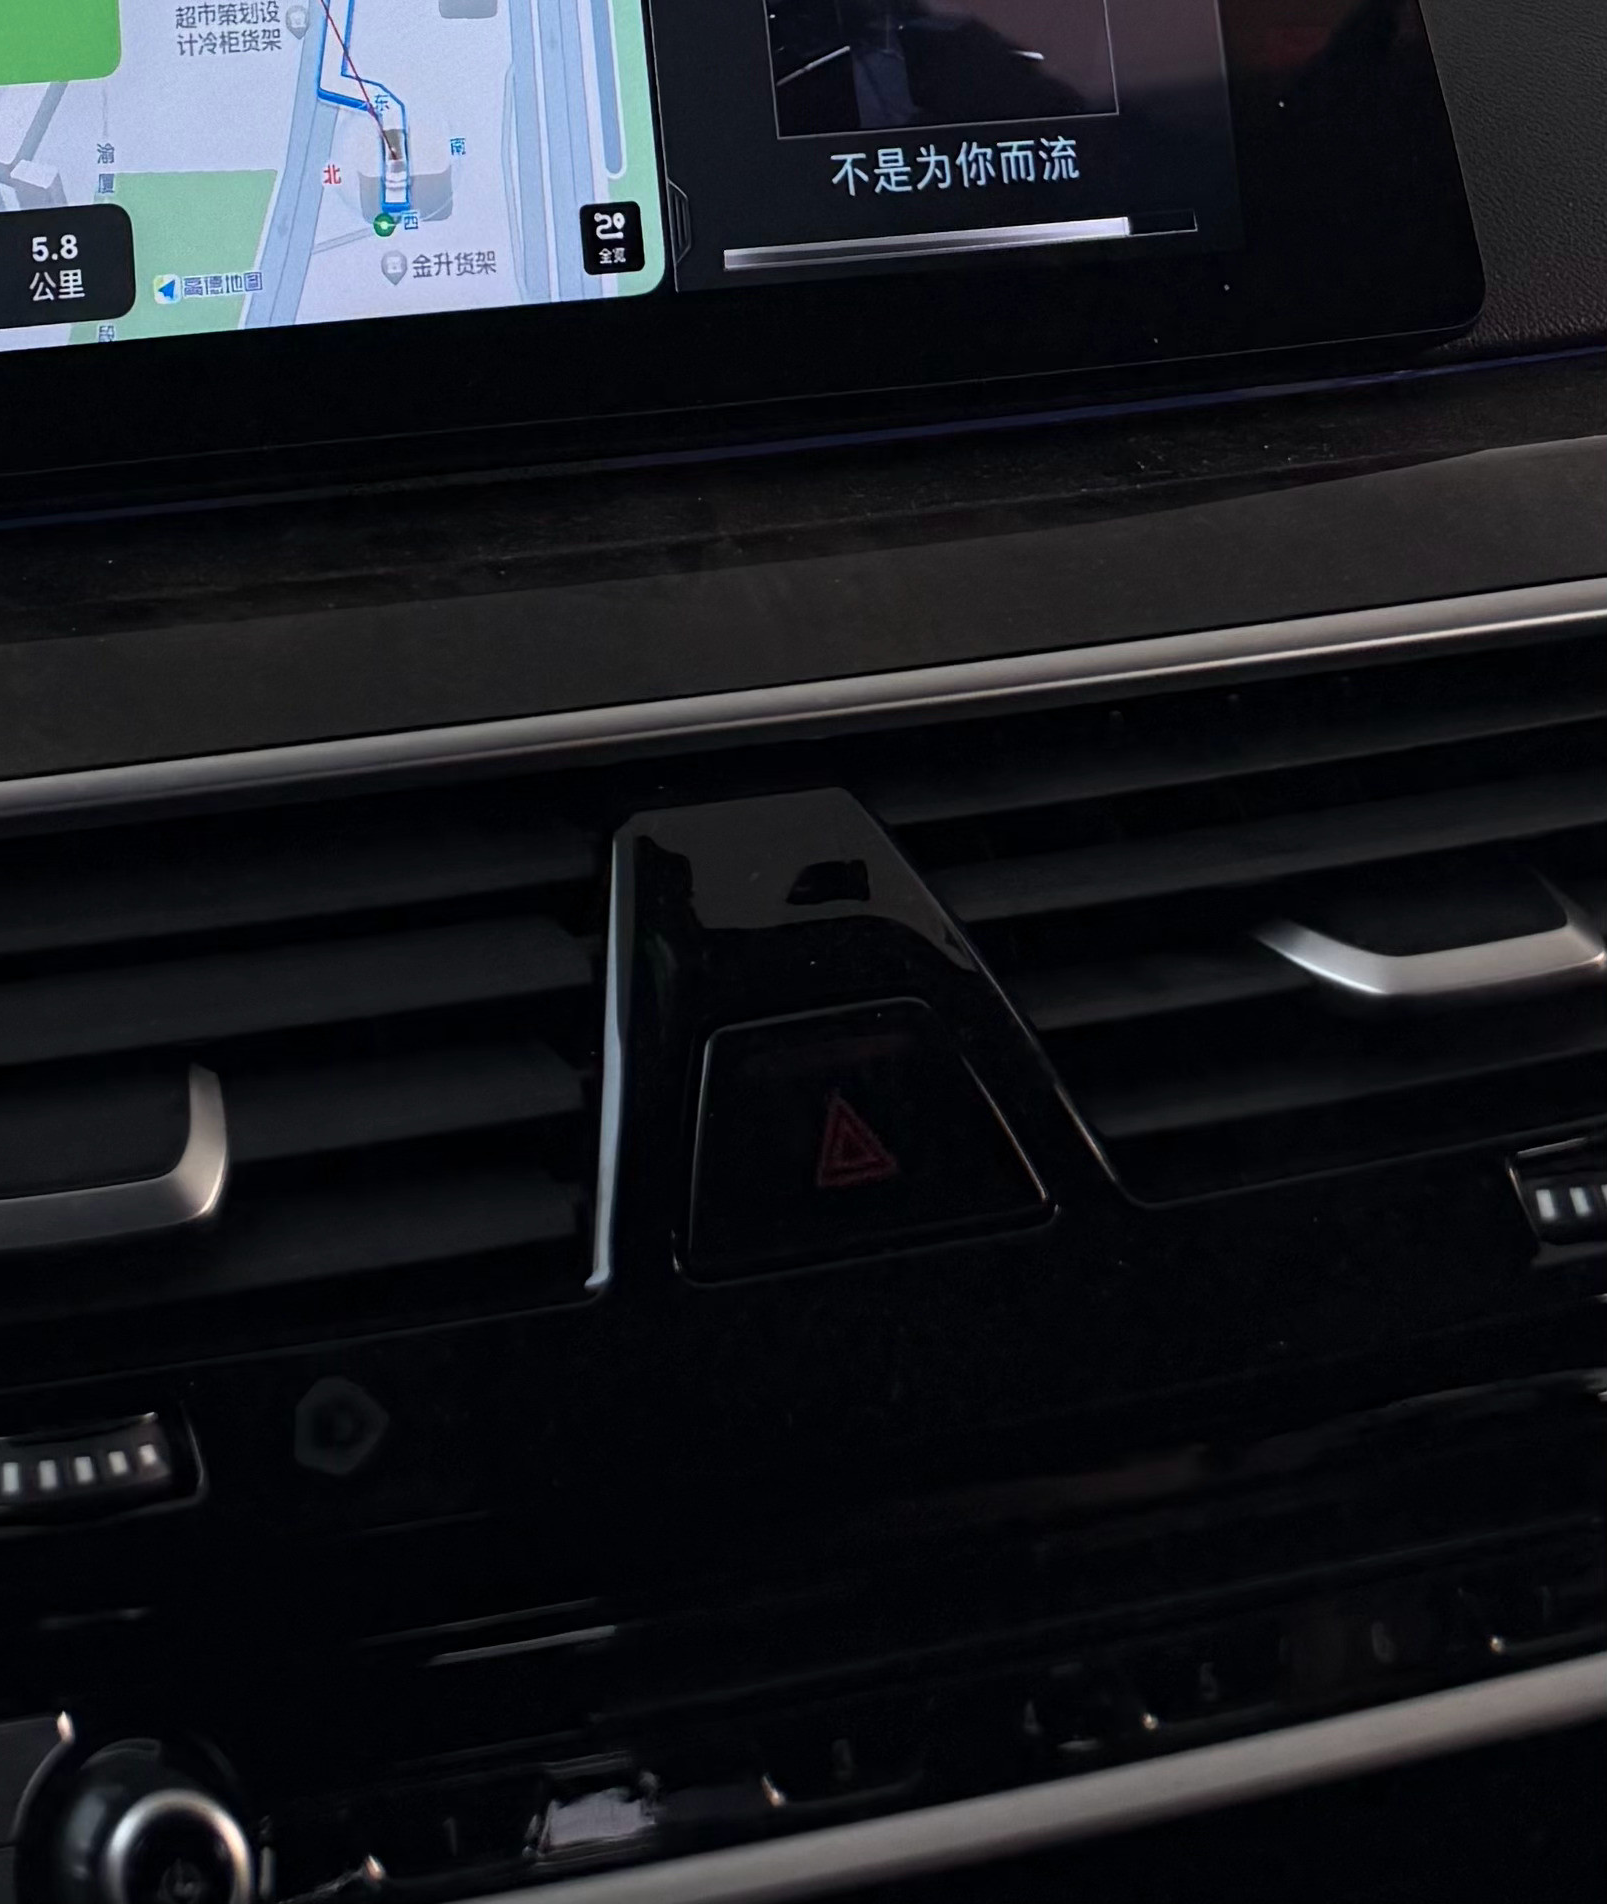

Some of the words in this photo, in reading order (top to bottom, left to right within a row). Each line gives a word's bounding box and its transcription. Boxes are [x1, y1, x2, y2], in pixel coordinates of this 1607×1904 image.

[175, 0, 282, 29] 超市策划设
[176, 28, 283, 57] 计冷柜货架
[323, 164, 342, 184] 北
[830, 136, 1081, 196] 不是为你而流
[30, 234, 79, 262] 5.8
[412, 250, 497, 279] 金升货架
[28, 269, 86, 302] 公里
